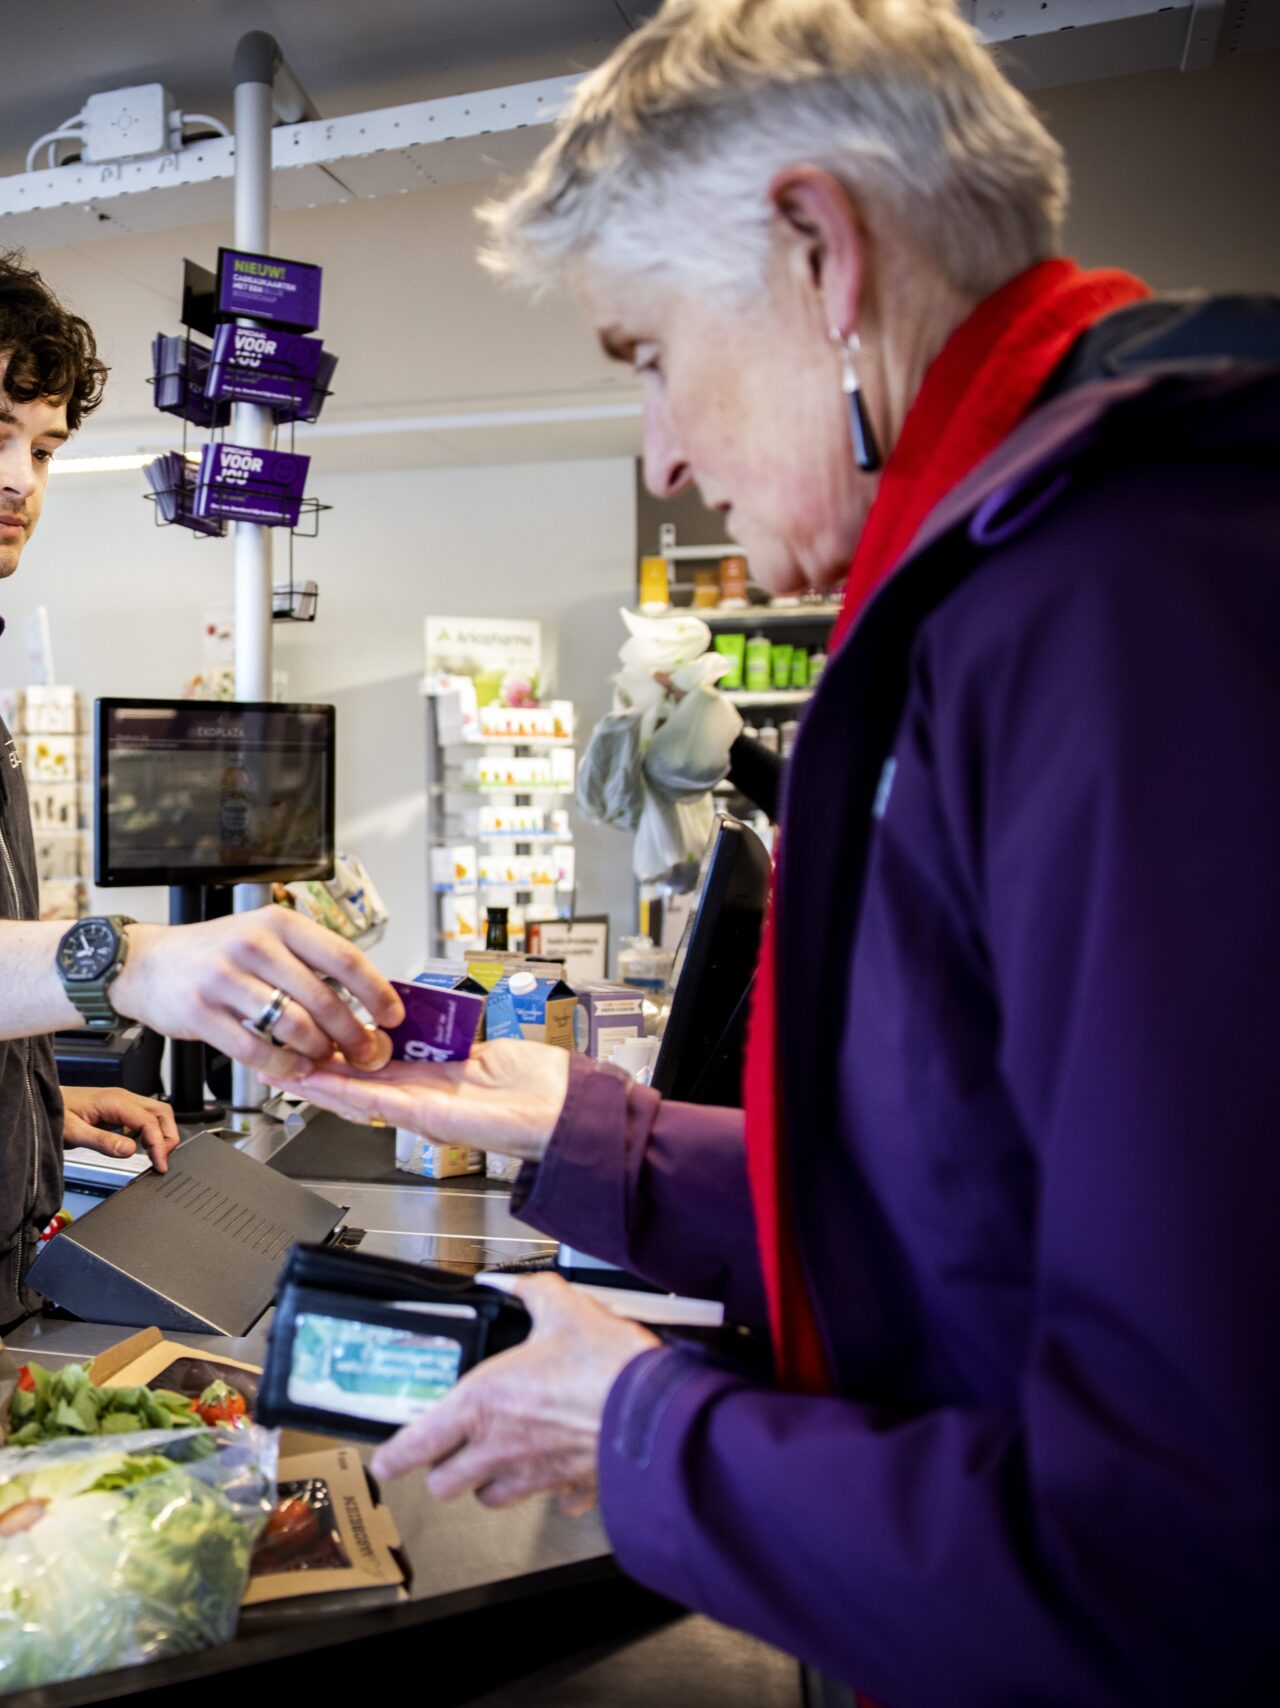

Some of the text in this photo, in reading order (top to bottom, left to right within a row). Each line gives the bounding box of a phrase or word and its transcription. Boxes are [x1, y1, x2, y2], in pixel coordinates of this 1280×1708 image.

[234, 259, 286, 279] NIEUW!
[248, 284, 263, 293] EEN
[234, 335, 277, 355] VOOR
[228, 350, 262, 368] JOU
[220, 452, 263, 472] VOOR
[215, 468, 249, 485] JOU
[197, 726, 245, 738] EKOPLAZA
